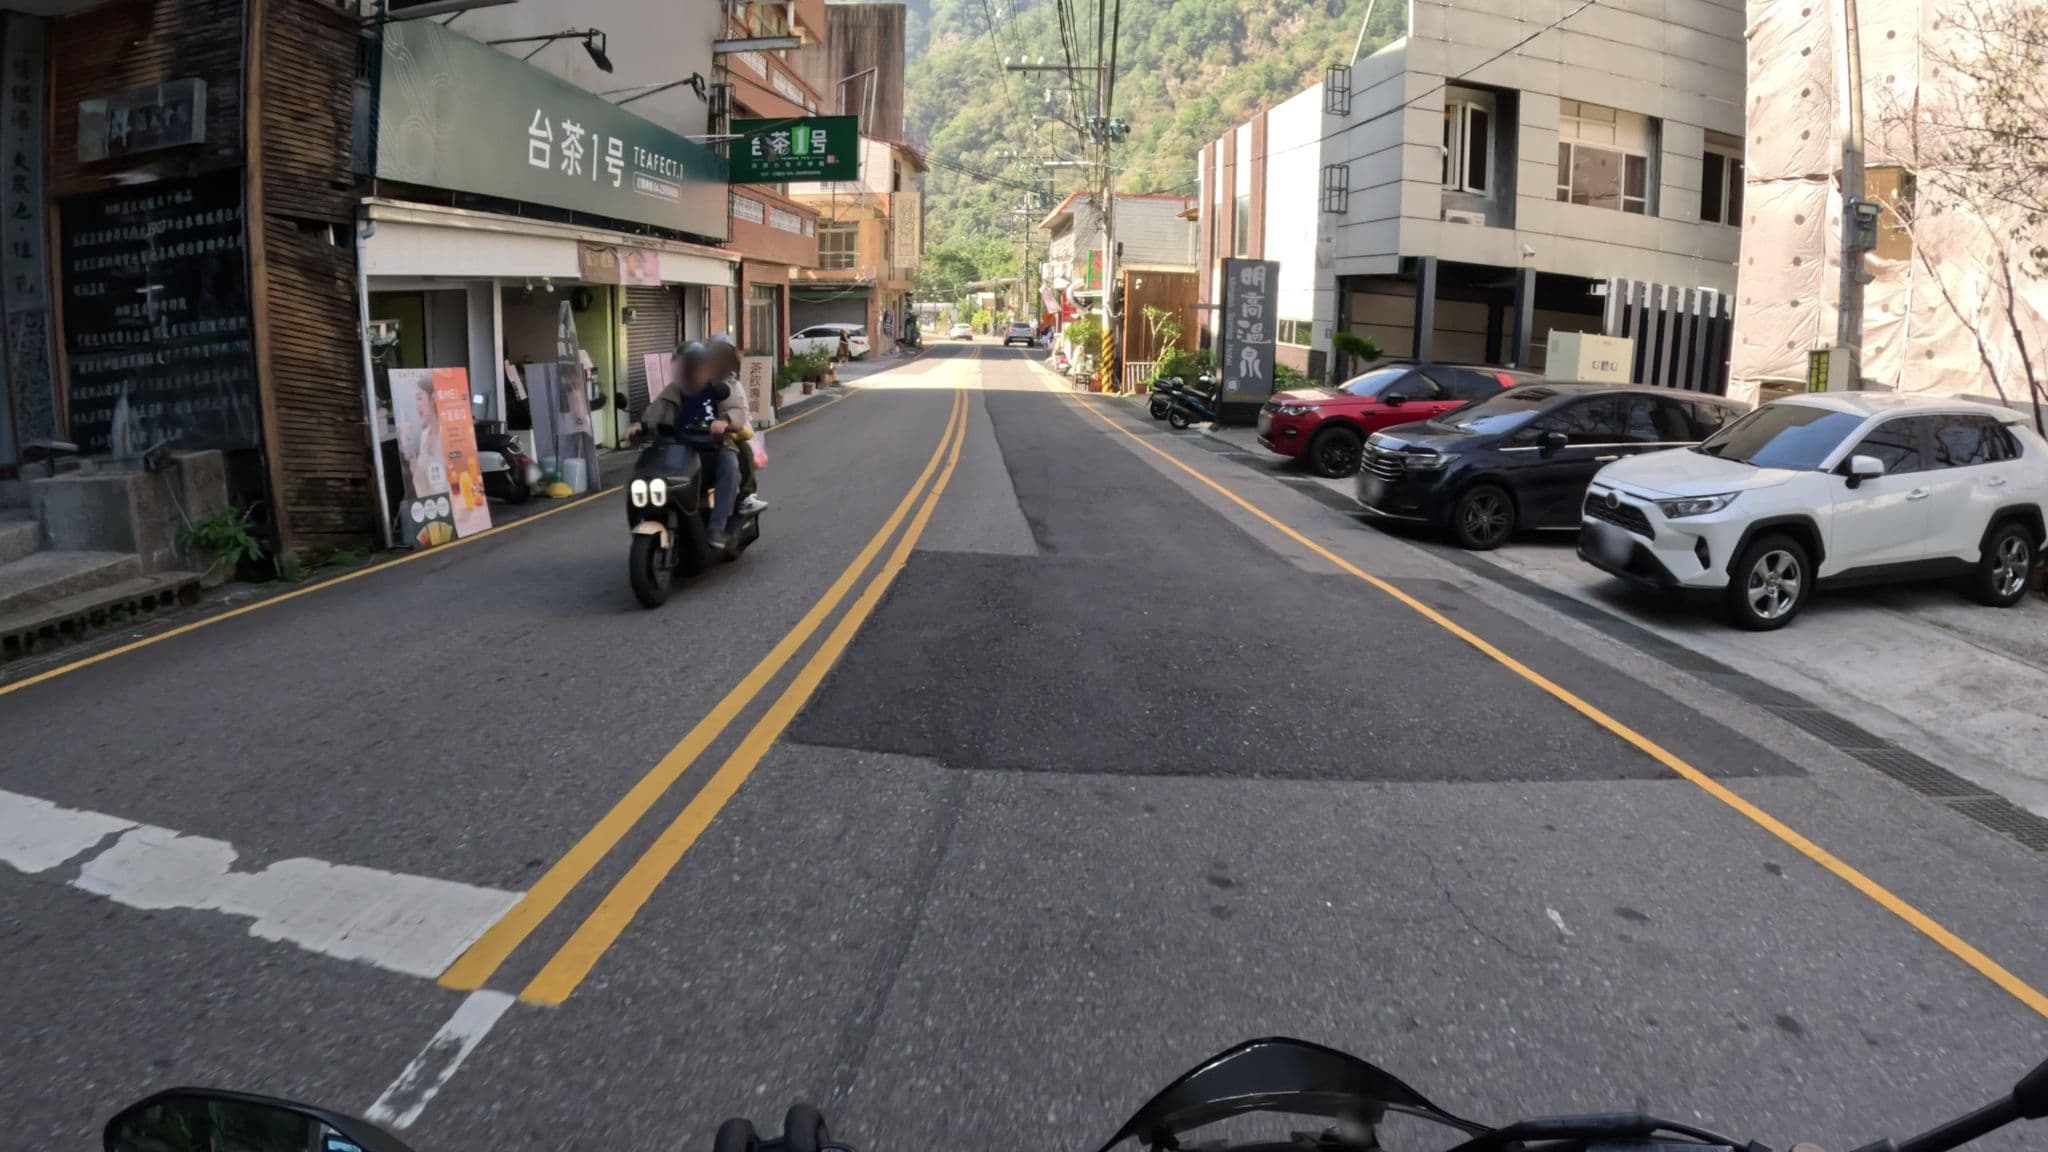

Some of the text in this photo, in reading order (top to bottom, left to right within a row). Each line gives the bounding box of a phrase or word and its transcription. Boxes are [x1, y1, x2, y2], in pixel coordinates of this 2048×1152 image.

[528, 108, 625, 187] 台茶1号
[633, 146, 684, 180] TEAFECT.1
